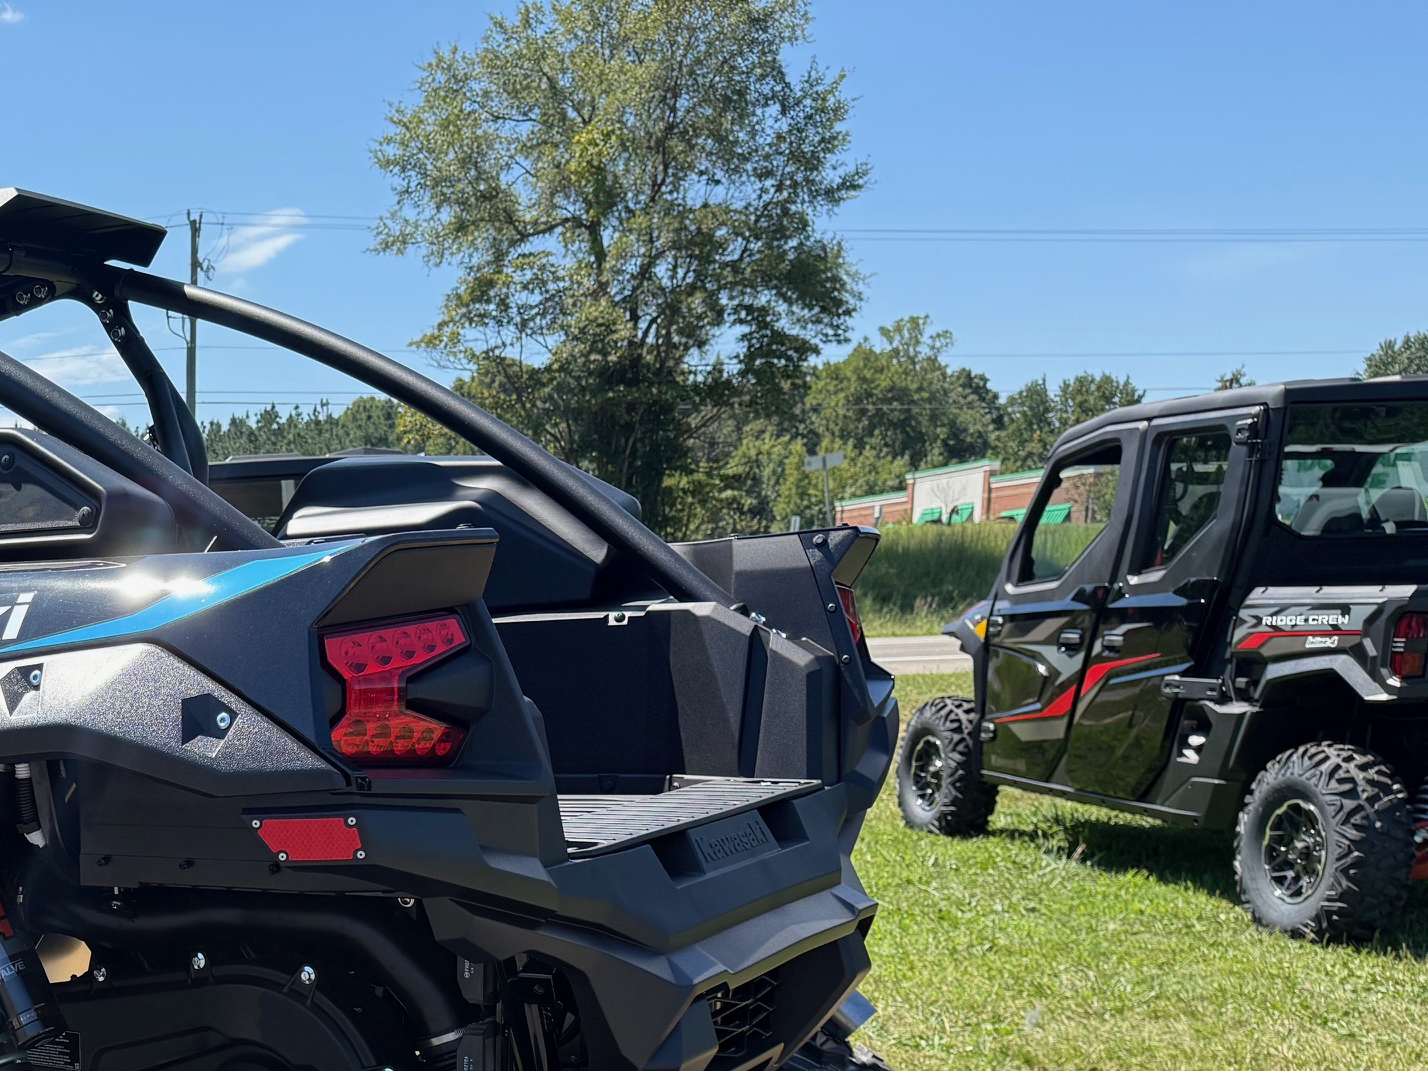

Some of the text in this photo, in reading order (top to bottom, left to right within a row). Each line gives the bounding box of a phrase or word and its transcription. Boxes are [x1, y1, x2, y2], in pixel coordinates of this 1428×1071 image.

[1262, 614, 1349, 626] RIDGE CREW
[694, 820, 769, 863] Kawasaki
